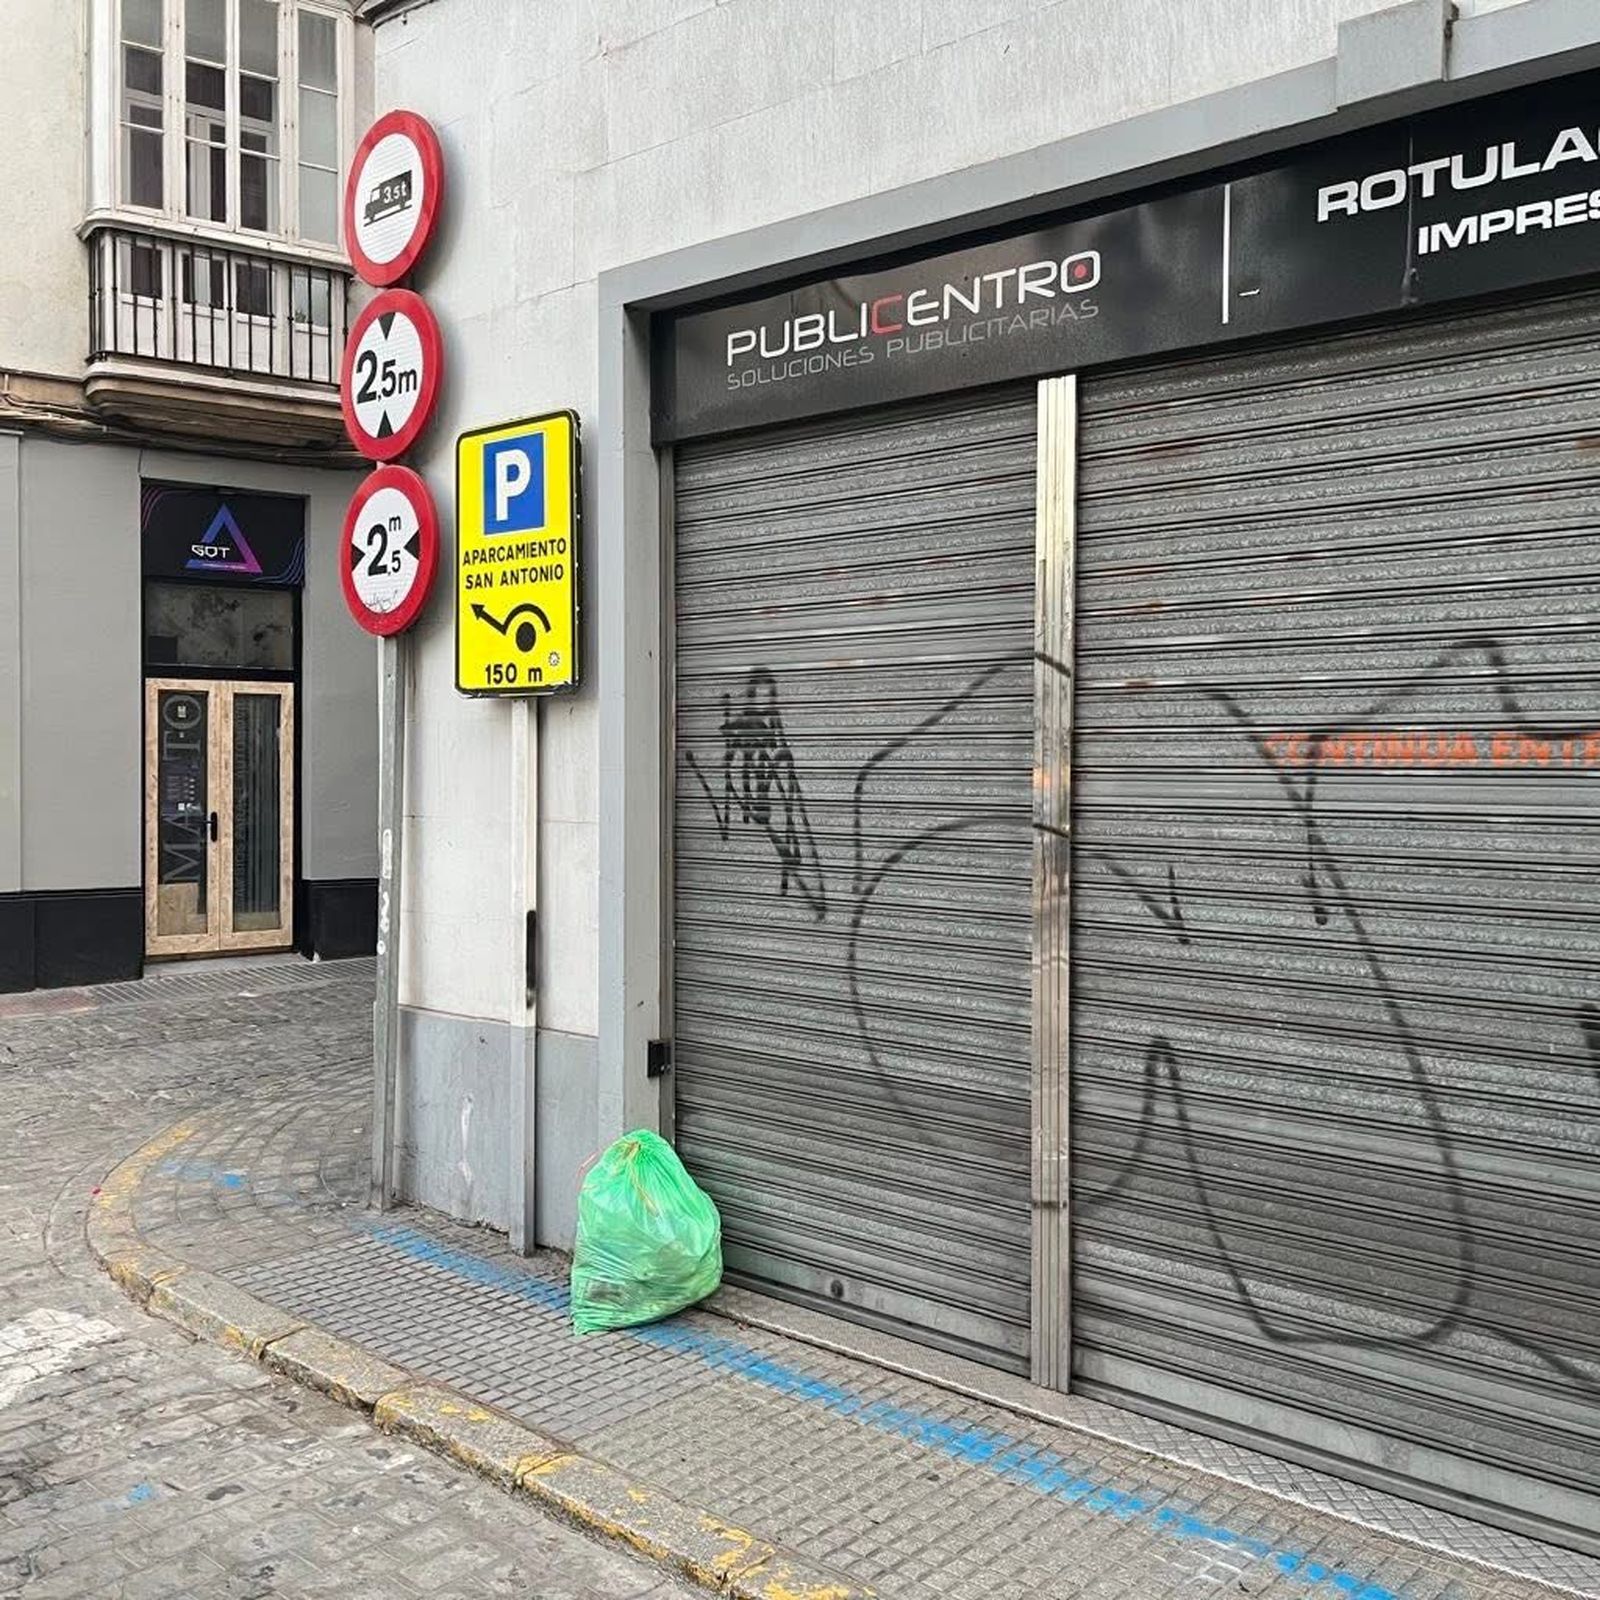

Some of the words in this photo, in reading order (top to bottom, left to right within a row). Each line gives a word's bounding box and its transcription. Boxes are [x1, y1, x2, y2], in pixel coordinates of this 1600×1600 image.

[1317, 126, 1600, 222] ROTULA
[727, 250, 1101, 366] PUBLICENTRO
[727, 345, 875, 390] SOLUCIONES
[886, 299, 1099, 357] PUBLICITARIAS
[495, 449, 531, 521] P
[462, 538, 567, 566] APARCAMIENTO
[465, 572, 493, 590] SAN
[500, 564, 564, 587] ANTONIO
[485, 662, 517, 685] 150
[528, 667, 543, 682] m
